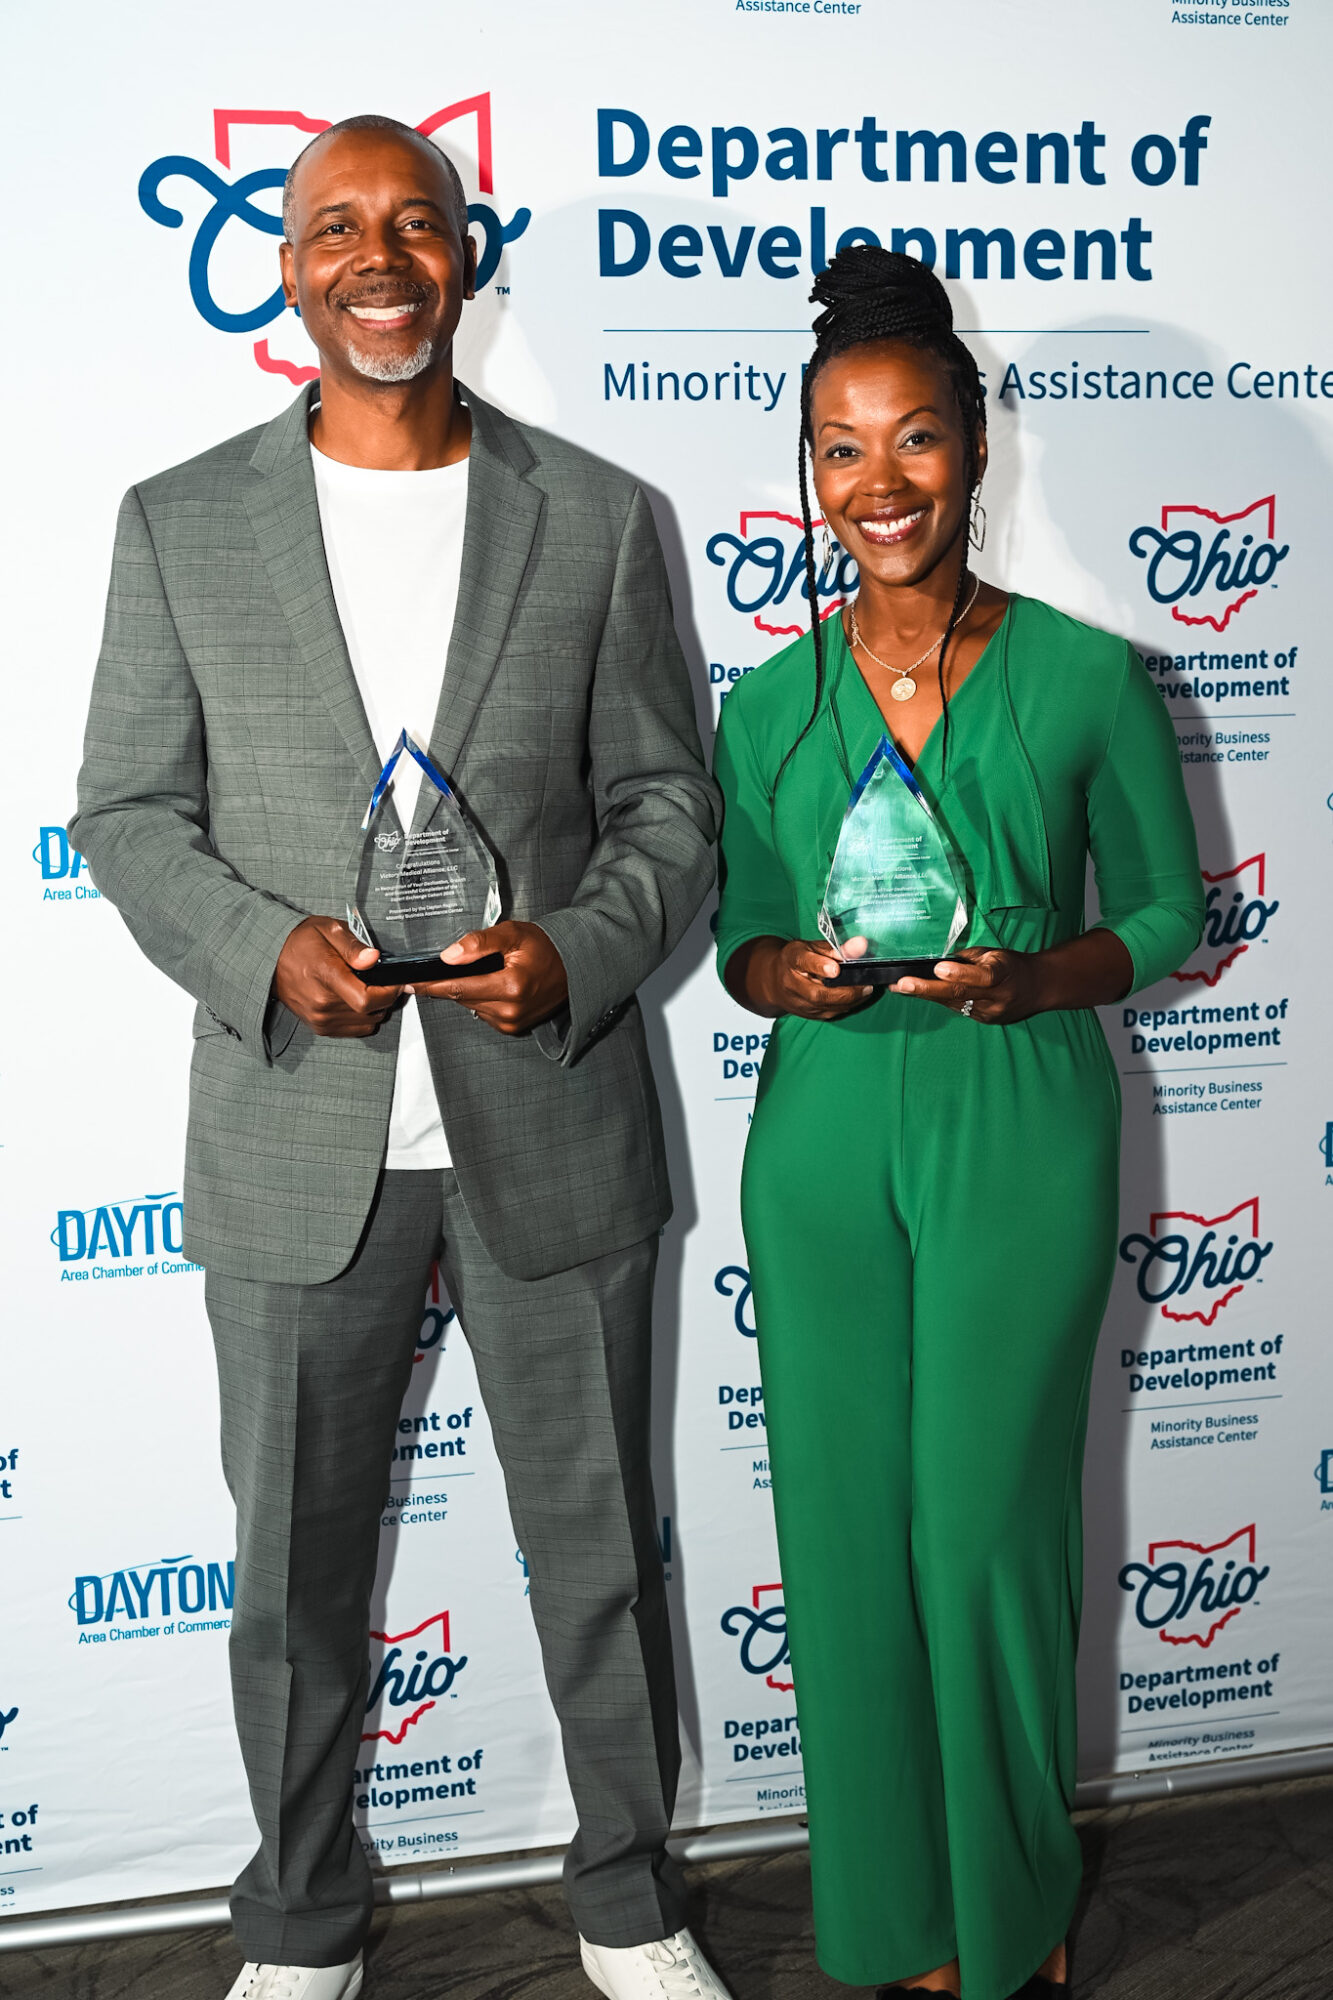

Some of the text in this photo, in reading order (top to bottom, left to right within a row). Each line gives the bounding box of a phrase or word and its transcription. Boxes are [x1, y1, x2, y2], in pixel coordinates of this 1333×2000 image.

[736, 0, 862, 14] Assistance Center
[1171, 11, 1290, 26] Assistance Center
[597, 108, 1212, 197] Department of
[603, 361, 787, 412] Minority
[998, 361, 1215, 400] Assistance
[1227, 362, 1333, 400] Cente
[1128, 526, 1290, 604] Ohio
[1138, 646, 1298, 676] epartment of
[1157, 677, 1290, 702] evelopment
[1176, 731, 1270, 748] nority Business
[1180, 749, 1270, 763] istance Center
[395, 859, 441, 870] Congratulations
[400, 869, 422, 877] Medical
[43, 888, 72, 901] Area
[1205, 887, 1280, 948] hio
[1123, 998, 1289, 1030] Department of
[1131, 1026, 1281, 1054] Development
[1152, 1080, 1263, 1098] Minority Business
[1152, 1097, 1262, 1115] Assistance Center
[57, 1202, 184, 1262] DAYTO
[60, 1268, 89, 1282] Area
[92, 1264, 144, 1280] Chamber
[147, 1262, 158, 1276] of
[1119, 1230, 1274, 1304] Ohio
[1121, 1334, 1284, 1370] Department of
[1129, 1362, 1276, 1392] Development
[446, 1407, 473, 1430] of
[1151, 1413, 1259, 1433] Minority Business
[1151, 1428, 1258, 1450] Assistance Center
[386, 1493, 448, 1509] Business
[400, 1510, 448, 1524] Center
[75, 1561, 235, 1626] DAYTON
[1118, 1557, 1270, 1629] Ohio
[78, 1619, 231, 1645] Area Chamber of Commerc
[365, 1647, 468, 1715] hio
[1120, 1652, 1281, 1691] Department of
[1128, 1679, 1273, 1714] Development
[1148, 1729, 1256, 1748] Minority Business
[352, 1748, 484, 1785] artment of
[355, 1776, 477, 1810] elopment
[757, 1784, 806, 1801] Minorit
[11, 1803, 39, 1827] of
[361, 1836, 395, 1853] ority
[397, 1831, 459, 1848] Business
